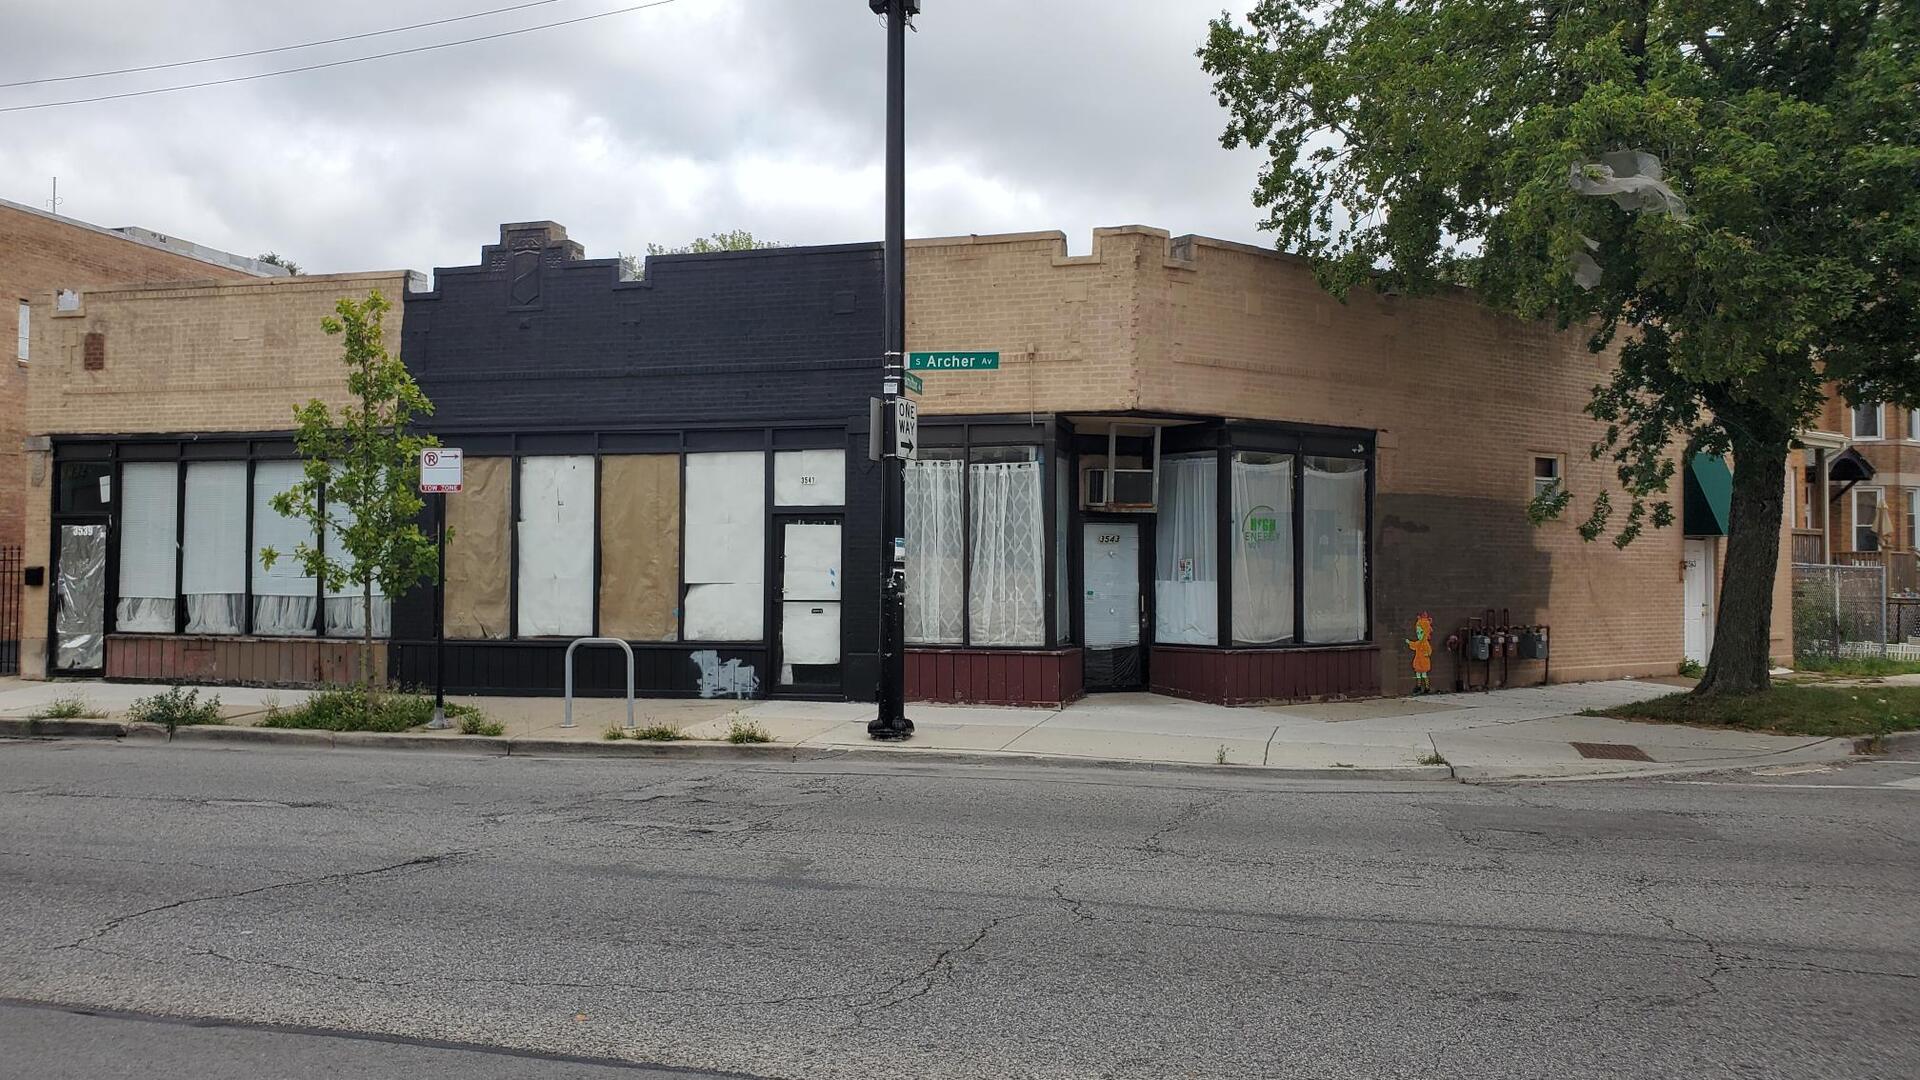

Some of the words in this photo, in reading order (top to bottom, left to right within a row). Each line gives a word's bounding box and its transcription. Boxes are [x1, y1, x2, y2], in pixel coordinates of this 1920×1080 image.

[914, 358, 922, 366] S
[926, 355, 976, 368] Archer
[899, 402, 915, 420] ONE
[899, 419, 916, 435] WAY
[801, 476, 815, 485] 3541
[73, 526, 94, 536] 3539
[1099, 535, 1121, 543] 3543
